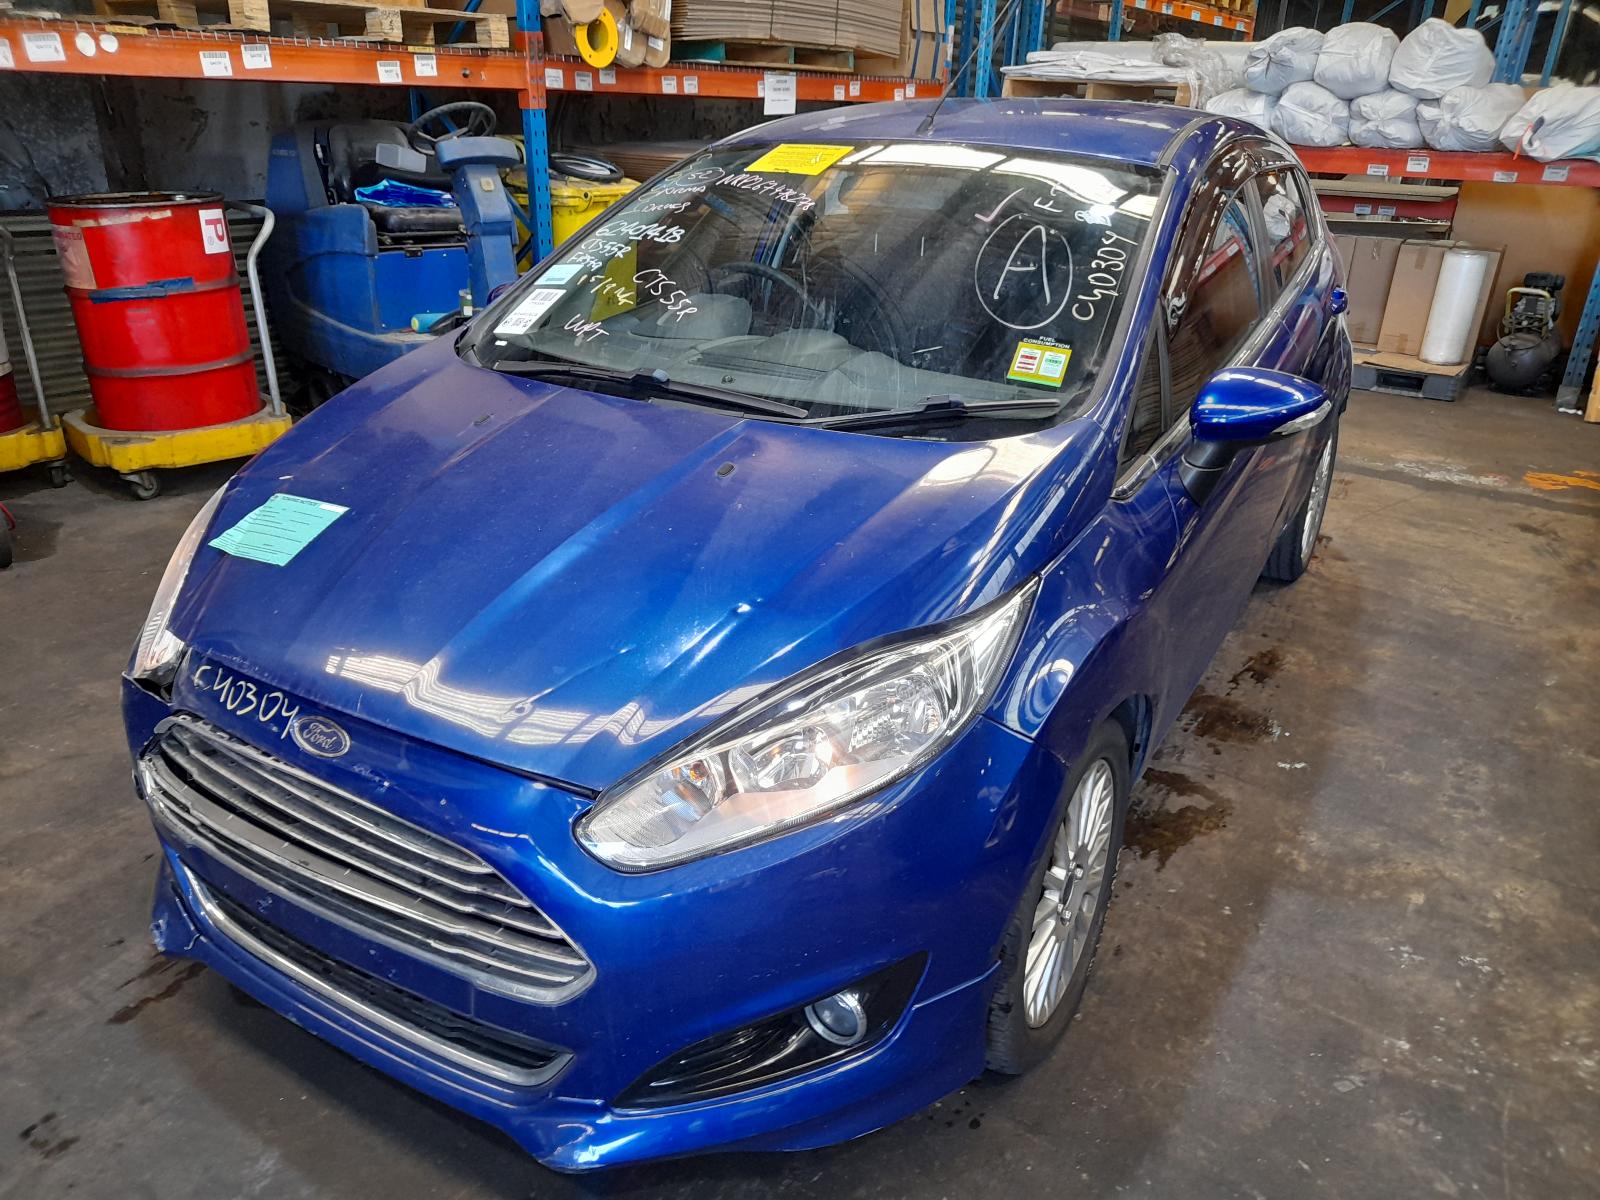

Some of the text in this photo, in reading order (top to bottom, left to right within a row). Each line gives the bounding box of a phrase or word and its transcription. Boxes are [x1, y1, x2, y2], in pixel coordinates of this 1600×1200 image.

[1023, 337, 1071, 350] CONSUMPTION
[1039, 335, 1056, 343] FUEL
[302, 721, 338, 750] Ford
